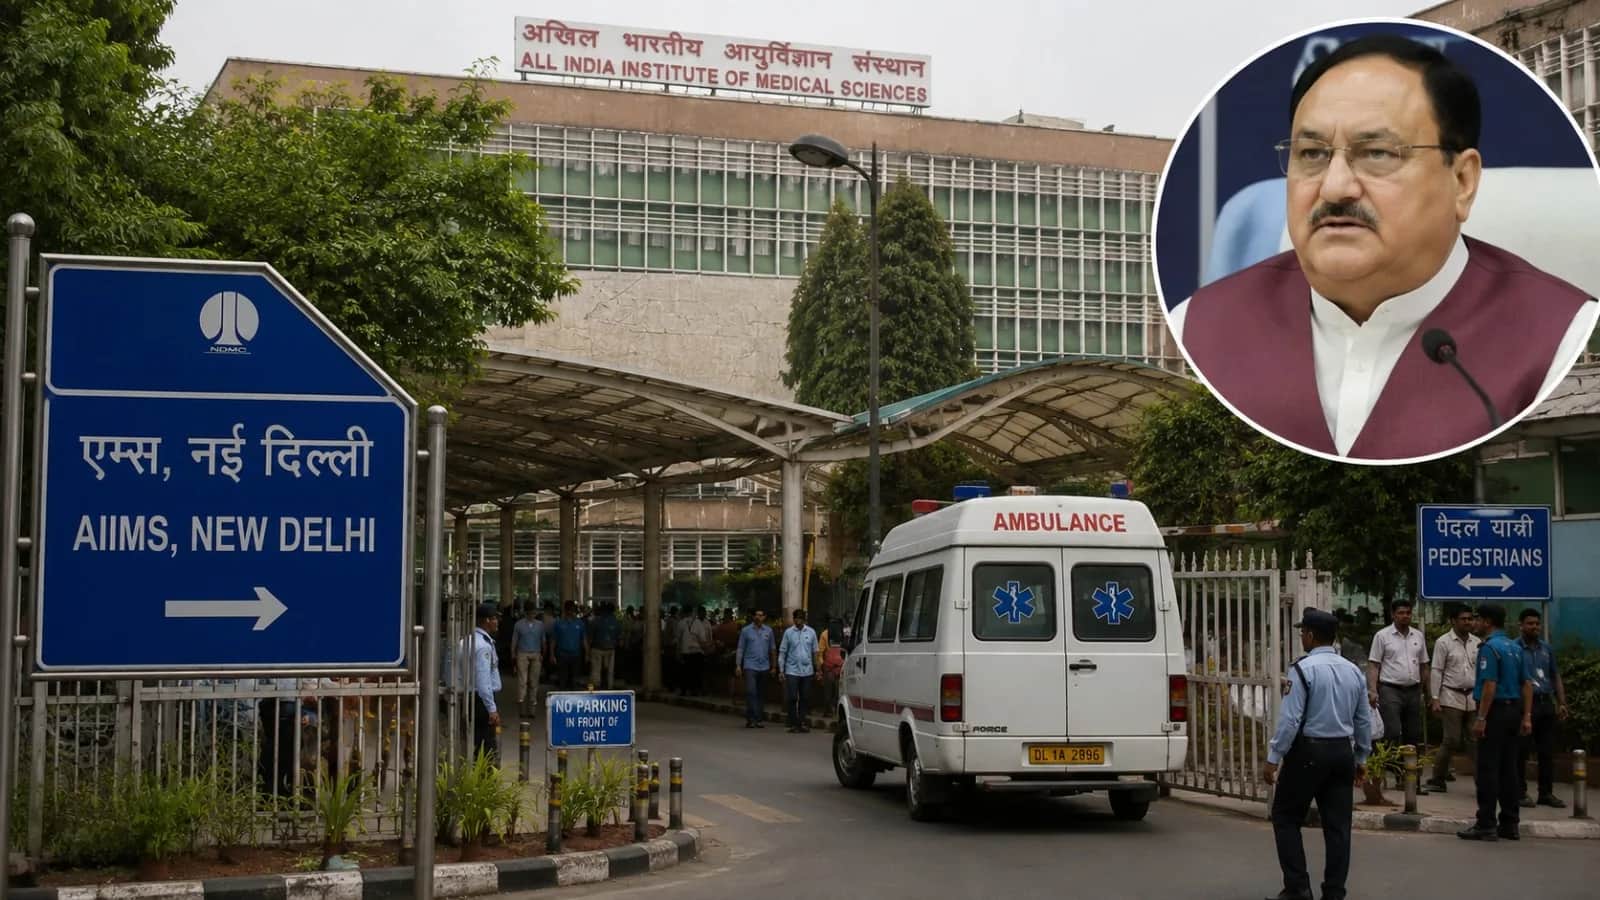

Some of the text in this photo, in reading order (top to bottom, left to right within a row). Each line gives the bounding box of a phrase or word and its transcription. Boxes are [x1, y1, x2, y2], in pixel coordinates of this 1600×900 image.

[522, 20, 926, 78] अखिल भारतीय आयुर्विज्ञान संस्थान
[520, 52, 928, 103] ALL INDIA INSTITUTE OF MEDICAL SCIENCES
[79, 423, 374, 484] एम्स, नई दिल्ली
[993, 512, 1127, 533] AMBULANCE
[1435, 511, 1480, 538] पैदल
[73, 515, 376, 557] AIIMS, NEW DELHI
[1428, 547, 1543, 567] PEDESTRIANS
[555, 698, 628, 713] NO PARKING
[566, 716, 619, 728] IN FRONT OF
[582, 730, 607, 742] GATE
[1034, 749, 1048, 761] DL
[1053, 749, 1066, 761] 1A
